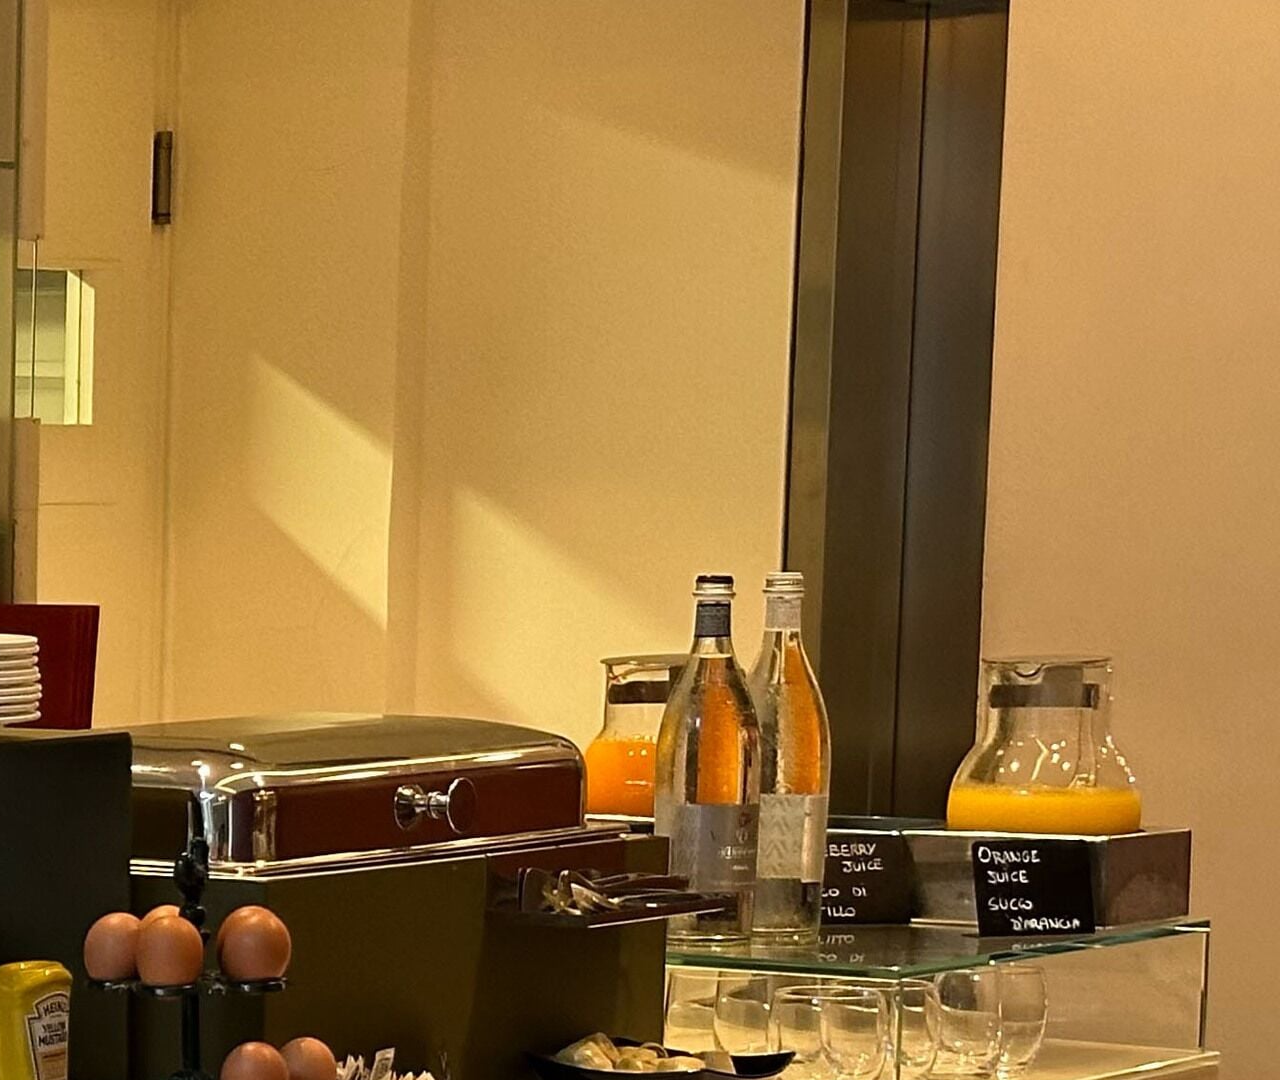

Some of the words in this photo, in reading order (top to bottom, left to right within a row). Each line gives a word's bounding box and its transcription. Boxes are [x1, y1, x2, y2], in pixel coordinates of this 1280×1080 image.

[978, 846, 1040, 865] ORANGE
[842, 858, 883, 873] JUICE
[987, 869, 1029, 884] JUICE
[988, 897, 1033, 910] SUCCO
